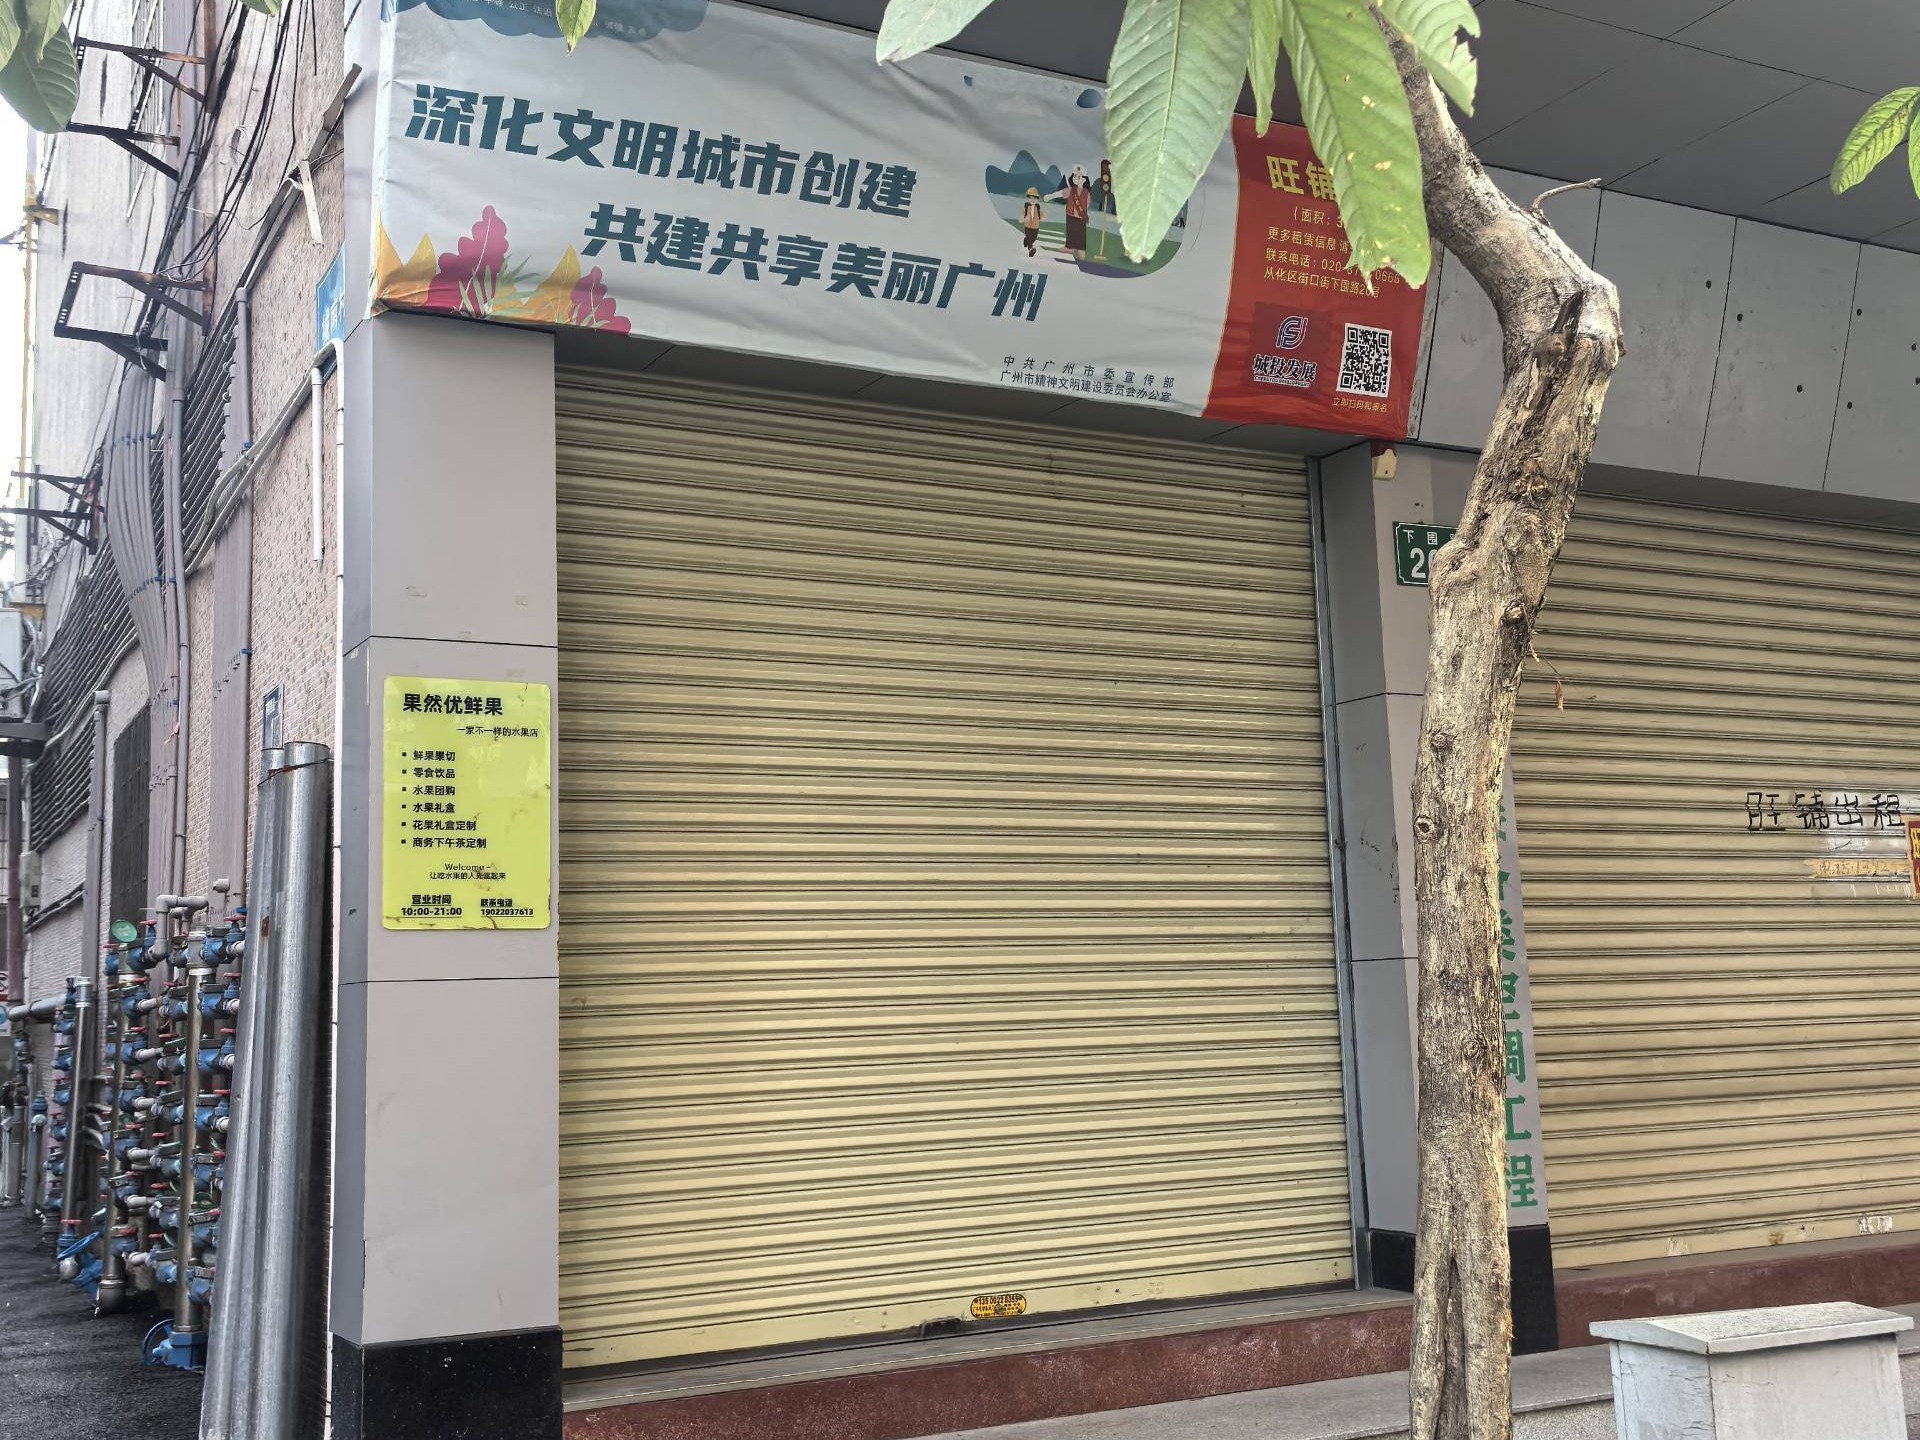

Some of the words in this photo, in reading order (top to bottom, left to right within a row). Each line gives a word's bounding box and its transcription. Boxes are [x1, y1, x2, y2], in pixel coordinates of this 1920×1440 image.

[404, 83, 918, 219] 深化文明城市创建
[1267, 226, 1336, 252] 更多租赁信息
[580, 202, 1049, 322] 共建共享美丽广州
[1002, 354, 1175, 389] 中共广州市委宣传部
[1252, 354, 1318, 382] 城投发展
[1000, 370, 1173, 402] 广州市精神文明建设委员会办公室
[402, 693, 504, 716] 果然优鲜果
[455, 725, 539, 738] 一家不一样的水果店
[412, 750, 456, 762] 鲜果果切
[412, 767, 456, 779] 零食饮品
[412, 785, 456, 796] 水果团购
[412, 802, 456, 814] 水果礼盒
[412, 819, 477, 832] 花果礼盒定制
[412, 837, 487, 849] 商务下午茶定制
[411, 894, 452, 905] 营业时间
[480, 898, 513, 907] 联系电话
[400, 907, 462, 916] 10:00-21:00
[480, 908, 534, 916] 19022037613
